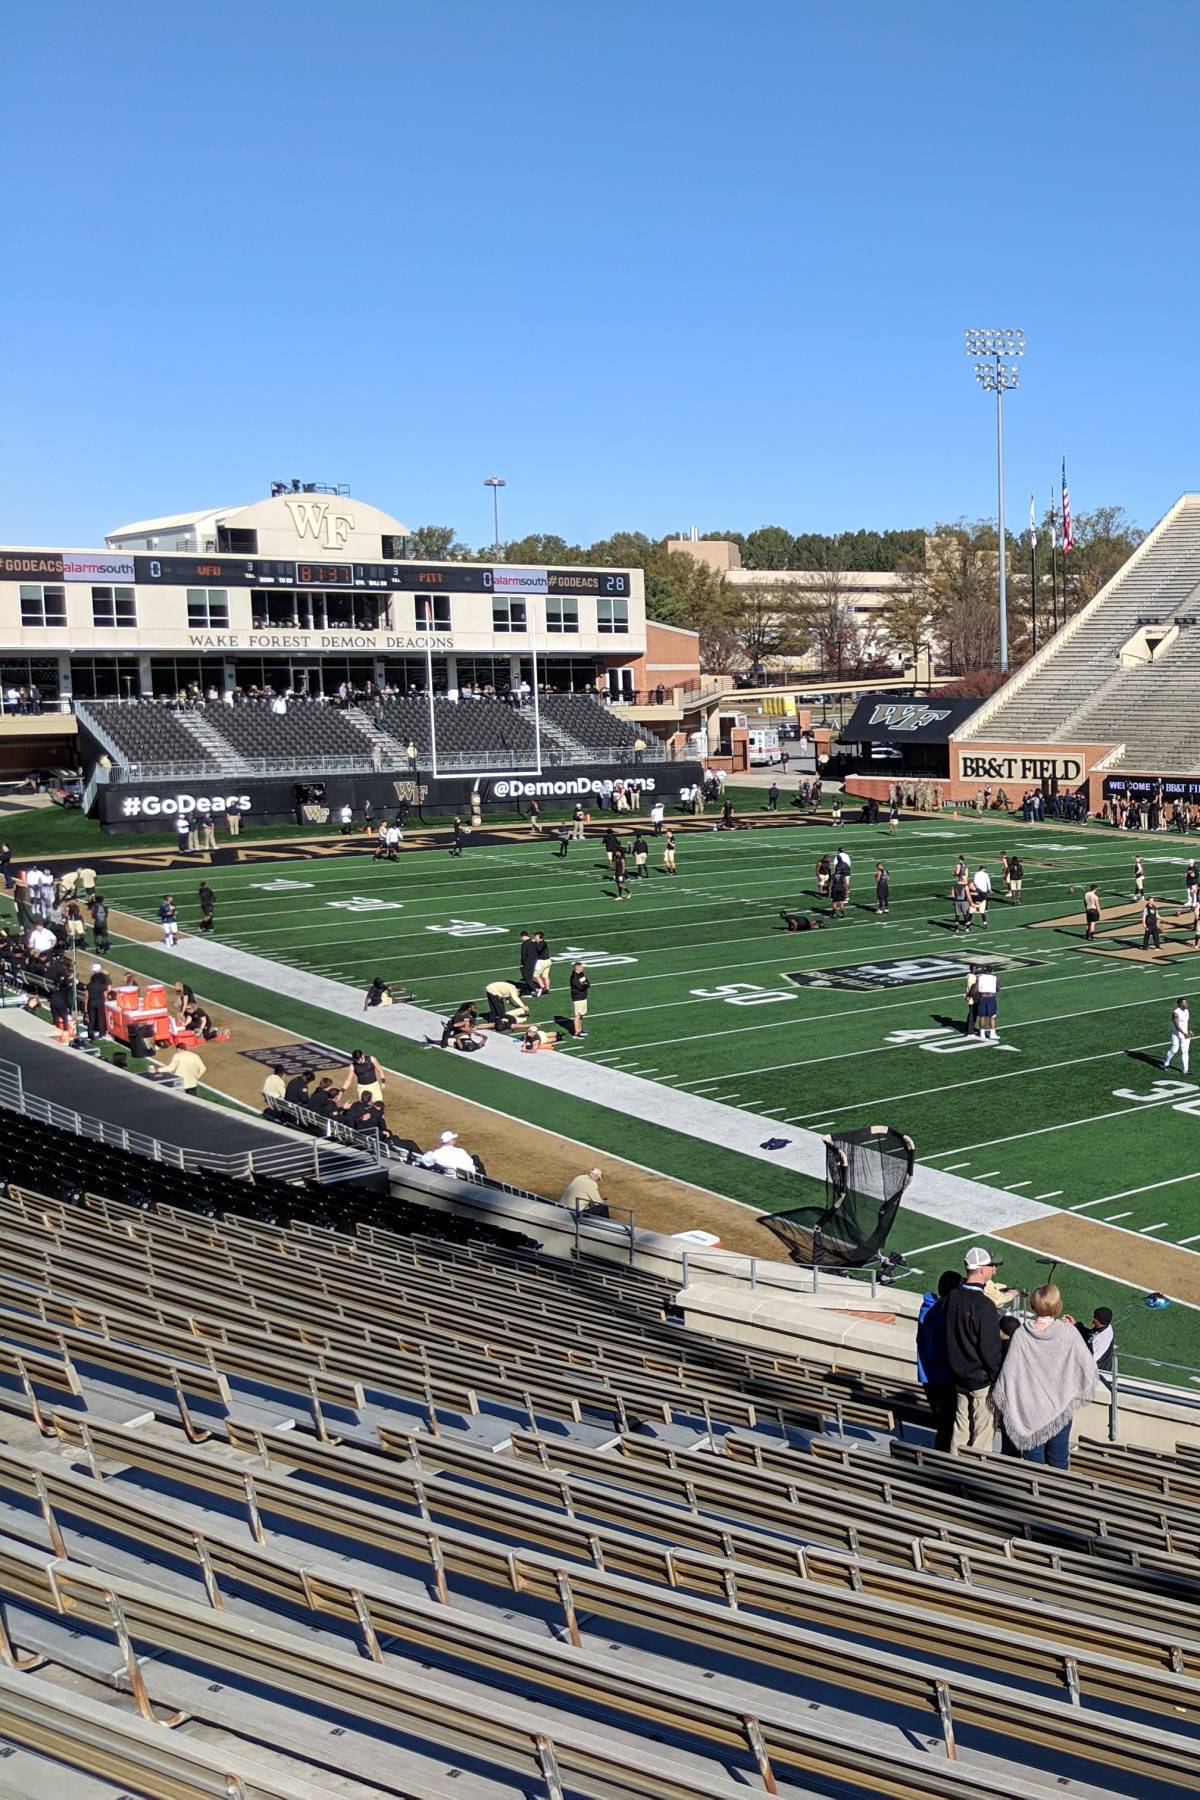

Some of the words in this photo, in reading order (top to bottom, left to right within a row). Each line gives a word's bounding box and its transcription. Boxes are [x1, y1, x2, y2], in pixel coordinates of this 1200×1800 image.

[285, 501, 354, 549] WF
[63, 561, 134, 575] alarmsouth
[493, 576, 548, 587] alarmsouth
[606, 576, 625, 591] 28
[188, 635, 239, 648] WAKE
[249, 635, 311, 648] FOREST
[321, 636, 377, 648] DEMON
[386, 636, 454, 649] DEACONS
[868, 703, 952, 731] WF
[961, 756, 1018, 780] BB&T
[1021, 758, 1081, 781] FIELD
[393, 781, 429, 805] WF
[1165, 783, 1187, 793] BB&T
[303, 805, 331, 823] WF
[689, 983, 799, 1006] 50
